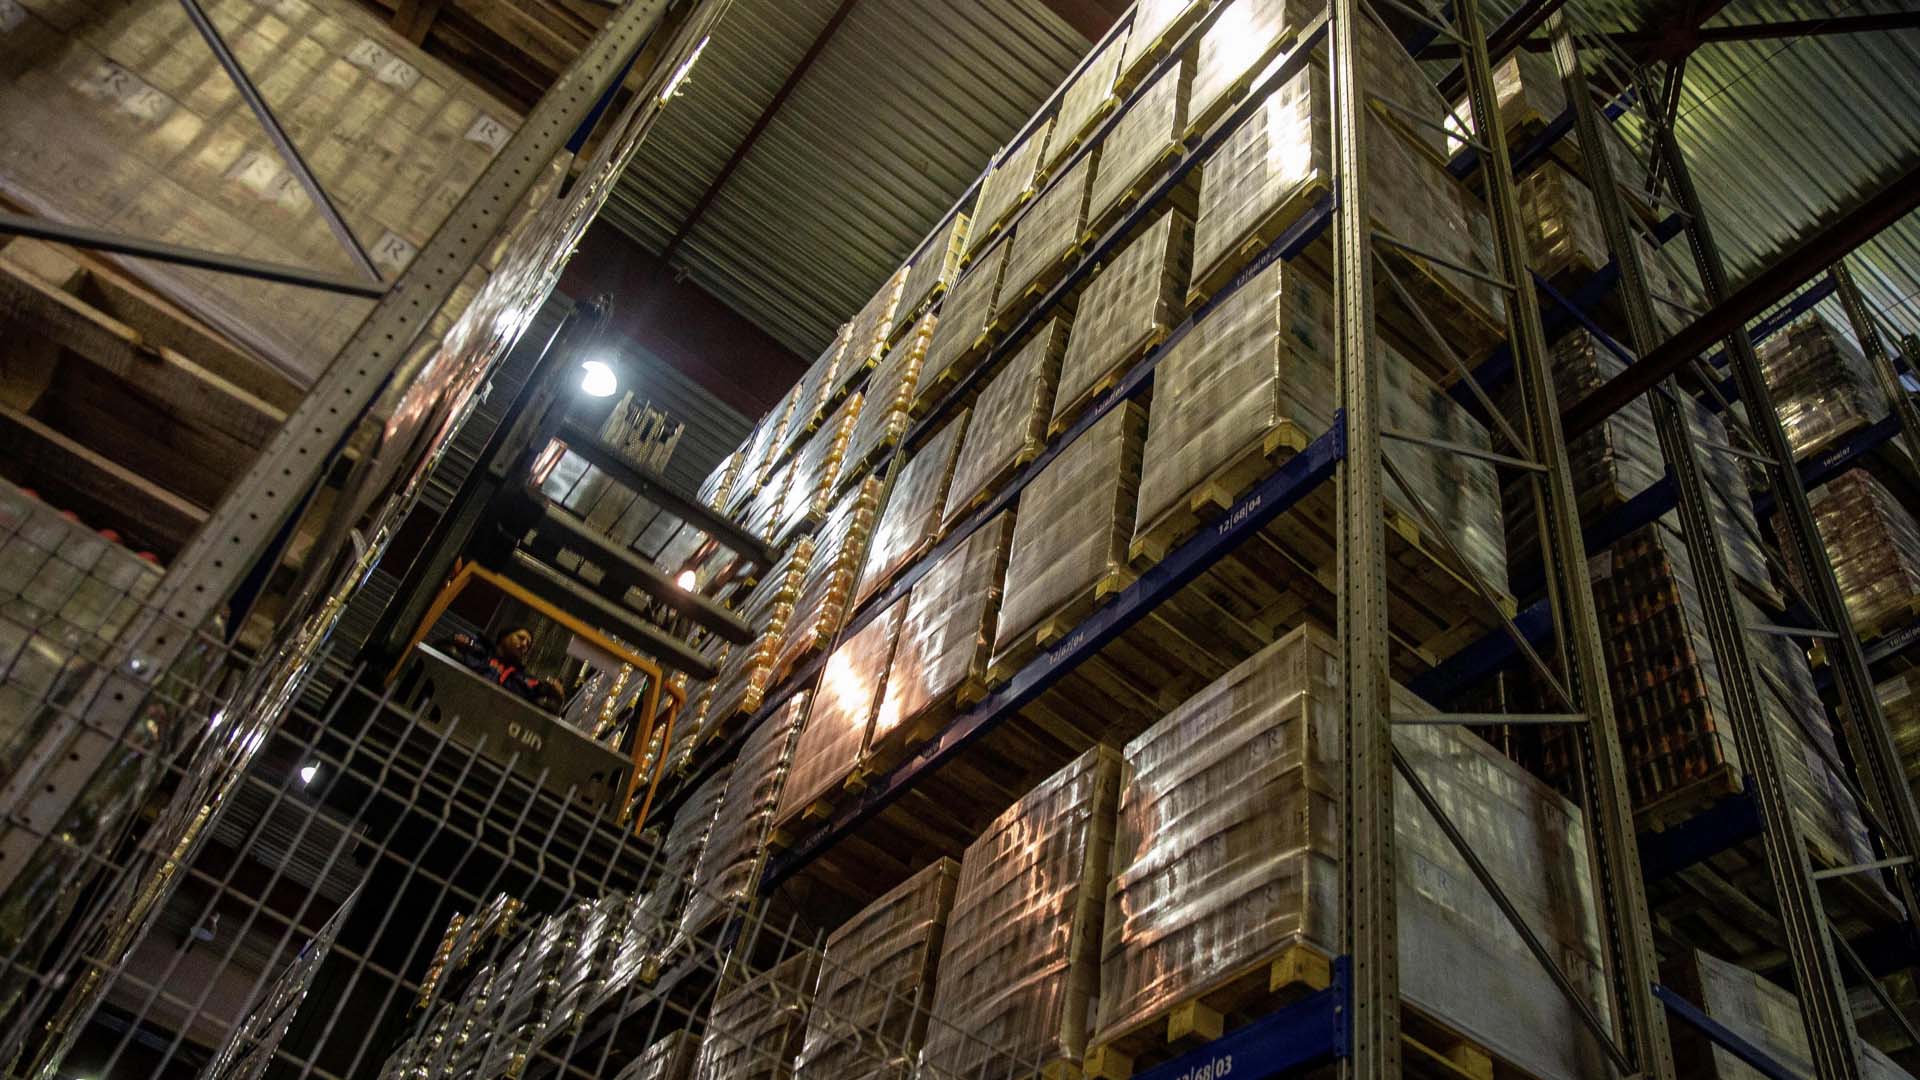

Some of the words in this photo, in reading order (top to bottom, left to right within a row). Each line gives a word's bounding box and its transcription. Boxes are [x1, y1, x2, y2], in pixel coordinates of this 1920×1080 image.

[479, 121, 499, 139] R
[383, 238, 405, 260] R
[1175, 1054, 1232, 1080] |68|03
